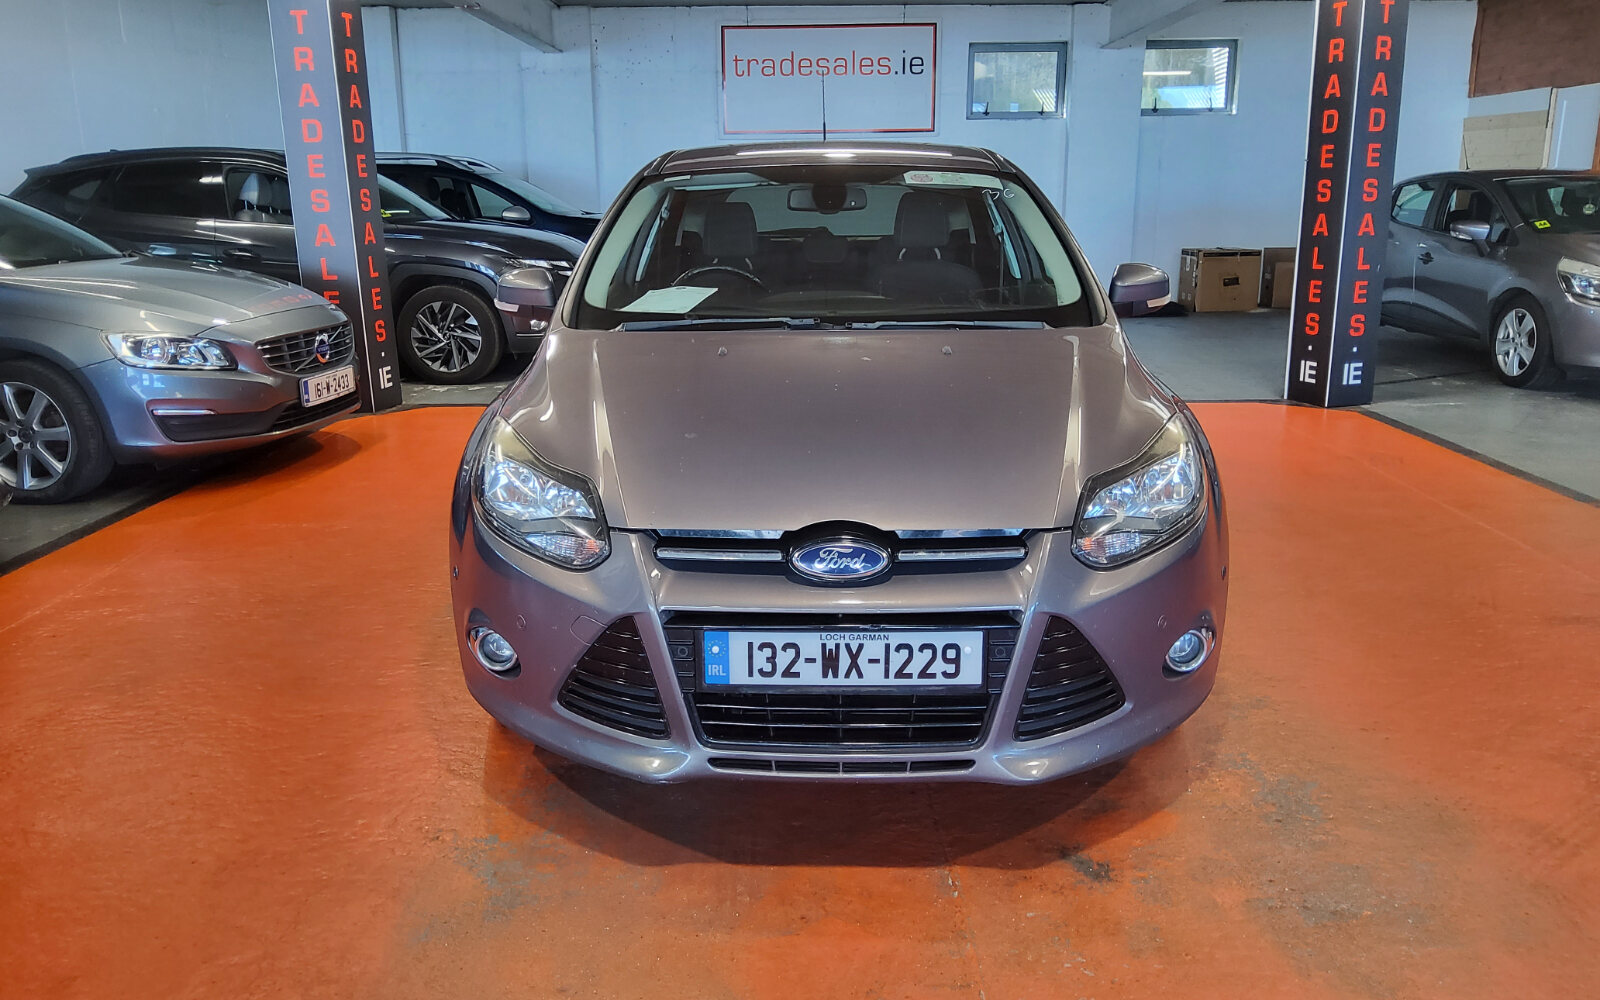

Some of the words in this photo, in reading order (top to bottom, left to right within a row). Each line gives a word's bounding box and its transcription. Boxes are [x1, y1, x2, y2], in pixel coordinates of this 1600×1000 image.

[733, 50, 925, 77] tradesales.ie
[314, 373, 350, 398] 161-W-2433
[814, 547, 871, 569] Ford
[820, 633, 846, 641] LOCH
[848, 633, 890, 641] GARMAN
[708, 665, 727, 676] IRL
[747, 641, 962, 680] 132-WX-1229
